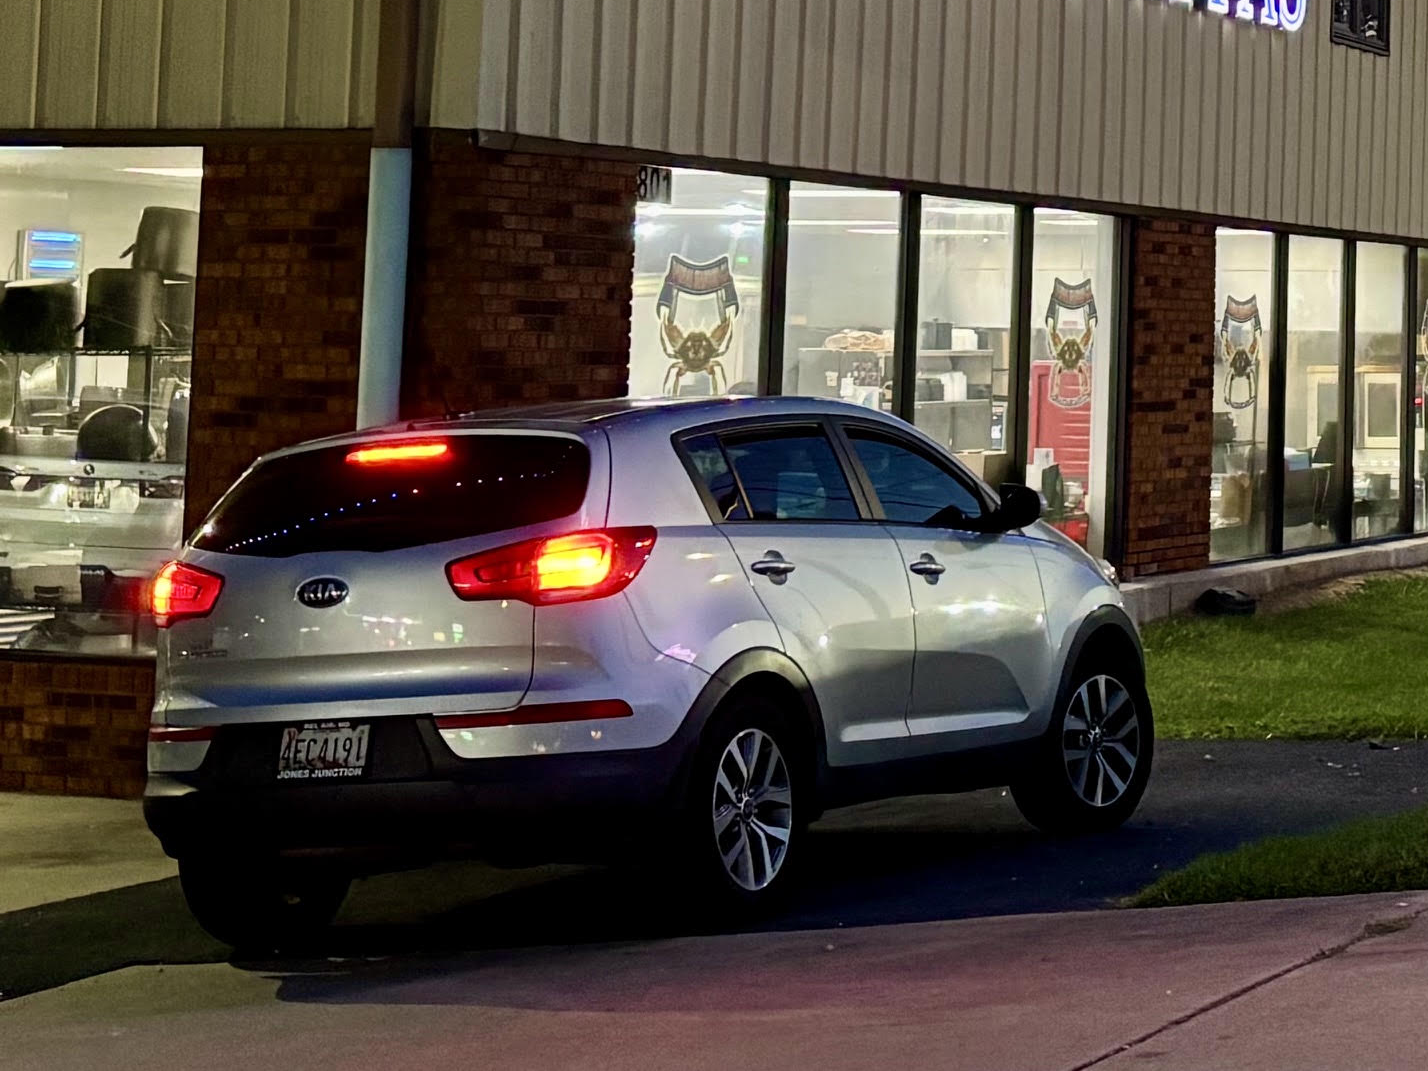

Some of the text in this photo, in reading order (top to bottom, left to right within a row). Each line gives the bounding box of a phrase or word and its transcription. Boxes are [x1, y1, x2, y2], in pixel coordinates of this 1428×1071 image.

[637, 166, 671, 202] 801
[303, 582, 347, 601] KIA
[277, 767, 363, 779] JONES JUNCTION
